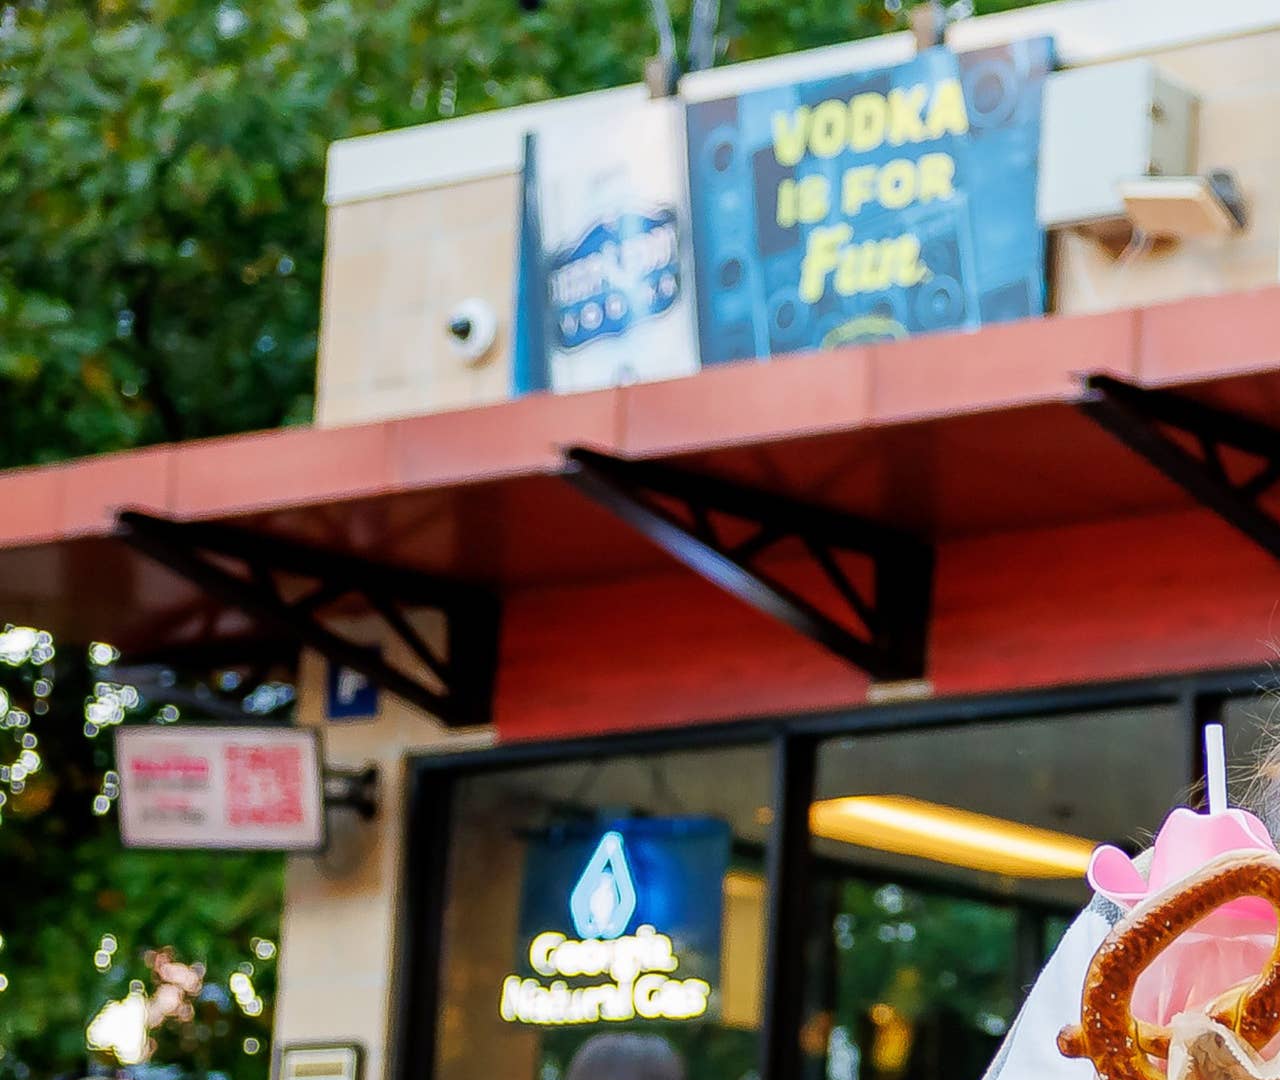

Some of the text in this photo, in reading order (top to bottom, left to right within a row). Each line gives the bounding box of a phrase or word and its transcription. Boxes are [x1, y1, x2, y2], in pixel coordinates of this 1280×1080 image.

[771, 78, 970, 167] VODKA
[775, 152, 956, 229] IS FOR
